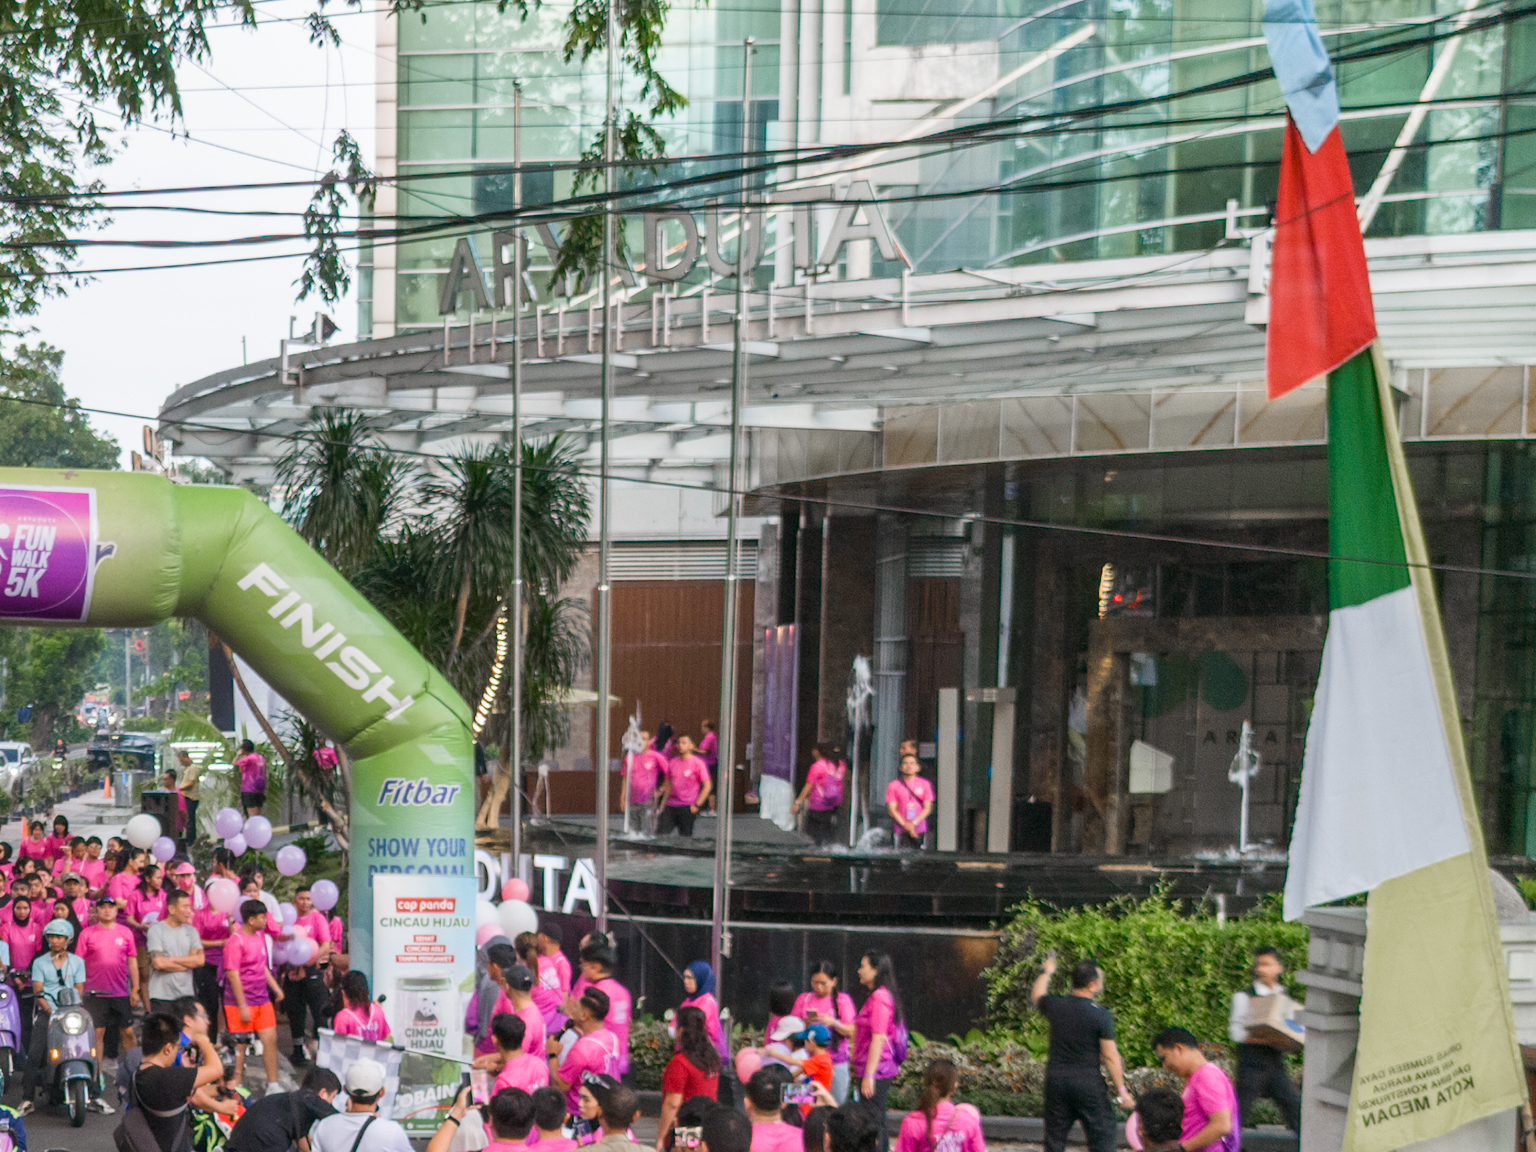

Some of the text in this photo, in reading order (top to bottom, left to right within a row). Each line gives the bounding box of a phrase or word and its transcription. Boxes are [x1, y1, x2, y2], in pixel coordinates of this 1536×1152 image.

[12, 524, 57, 552] FUN
[11, 549, 51, 568] WALK
[4, 567, 47, 598] 5K
[237, 563, 415, 722] FINISH
[1204, 730, 1277, 744] ARA
[377, 777, 460, 806] Fitbar
[368, 838, 466, 857] SHOW YOUR
[397, 899, 453, 912] cap panda
[380, 917, 470, 928] CINCAU HIJAU
[404, 1028, 447, 1038] CINCAU
[410, 1040, 444, 1049] HIJAU
